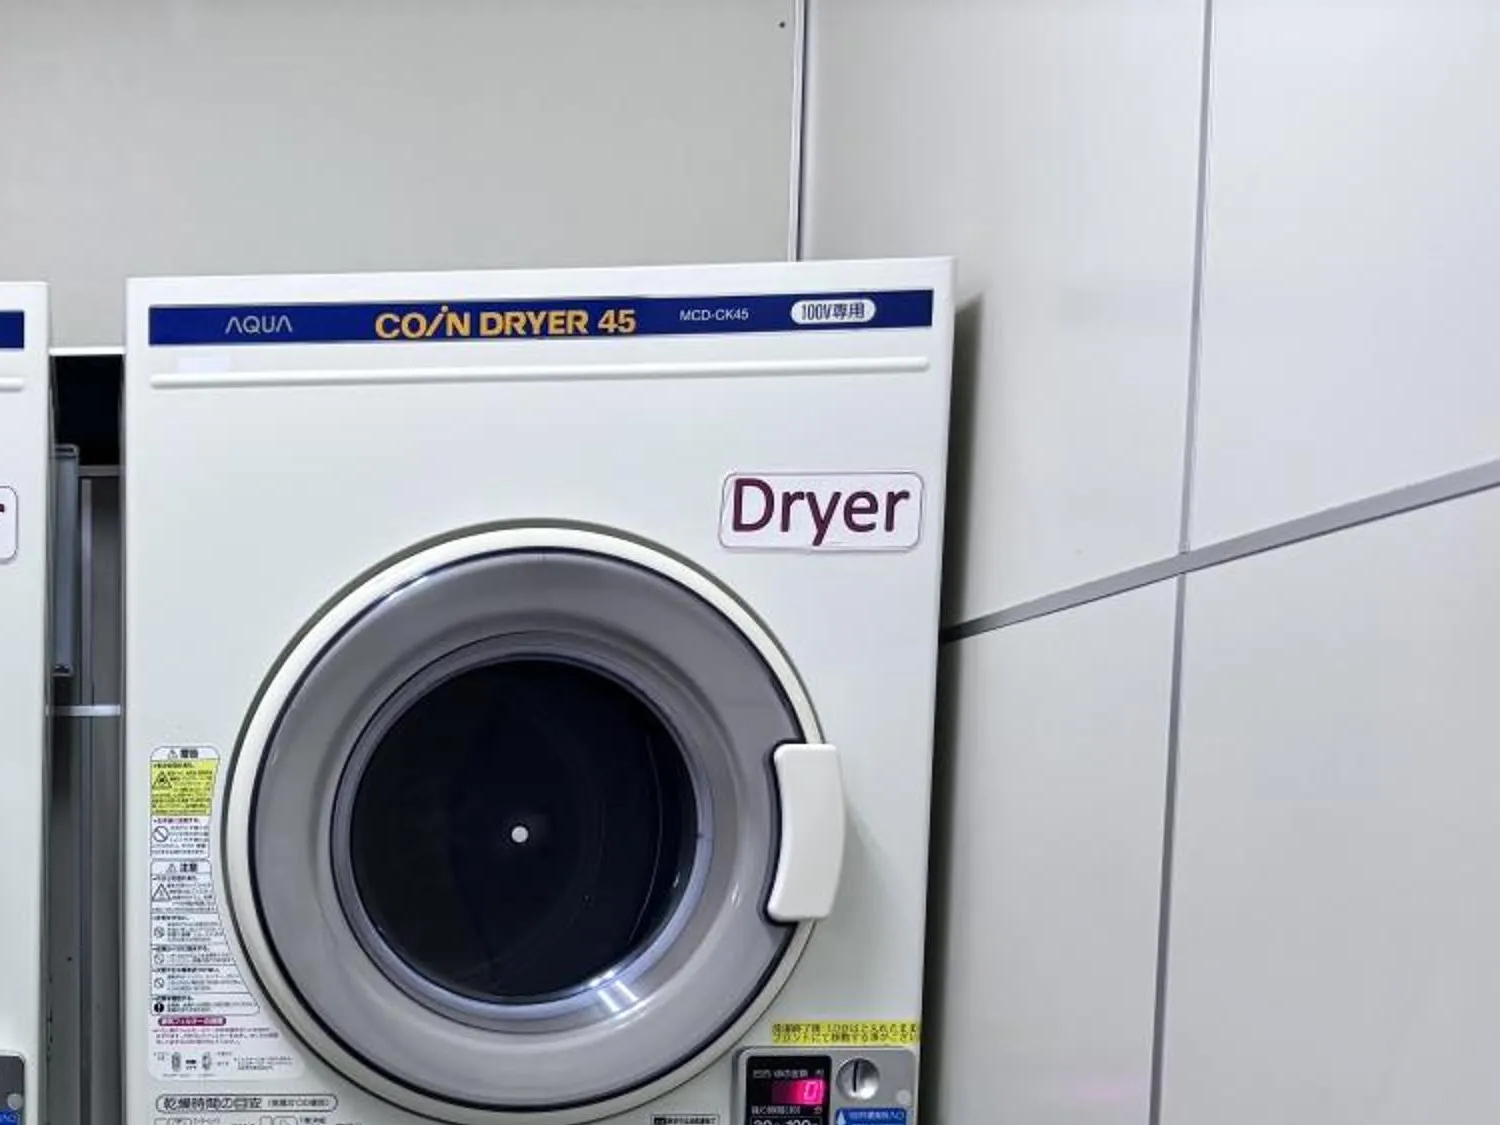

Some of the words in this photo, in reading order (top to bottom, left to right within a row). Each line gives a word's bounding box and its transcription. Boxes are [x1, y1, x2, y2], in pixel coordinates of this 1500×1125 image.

[480, 310, 589, 336] DRYER
[597, 307, 636, 334] 45
[678, 307, 749, 322] MCD-CK45
[799, 301, 865, 322] 100V専用
[225, 315, 293, 335] AQUA
[730, 477, 911, 546] Dryer
